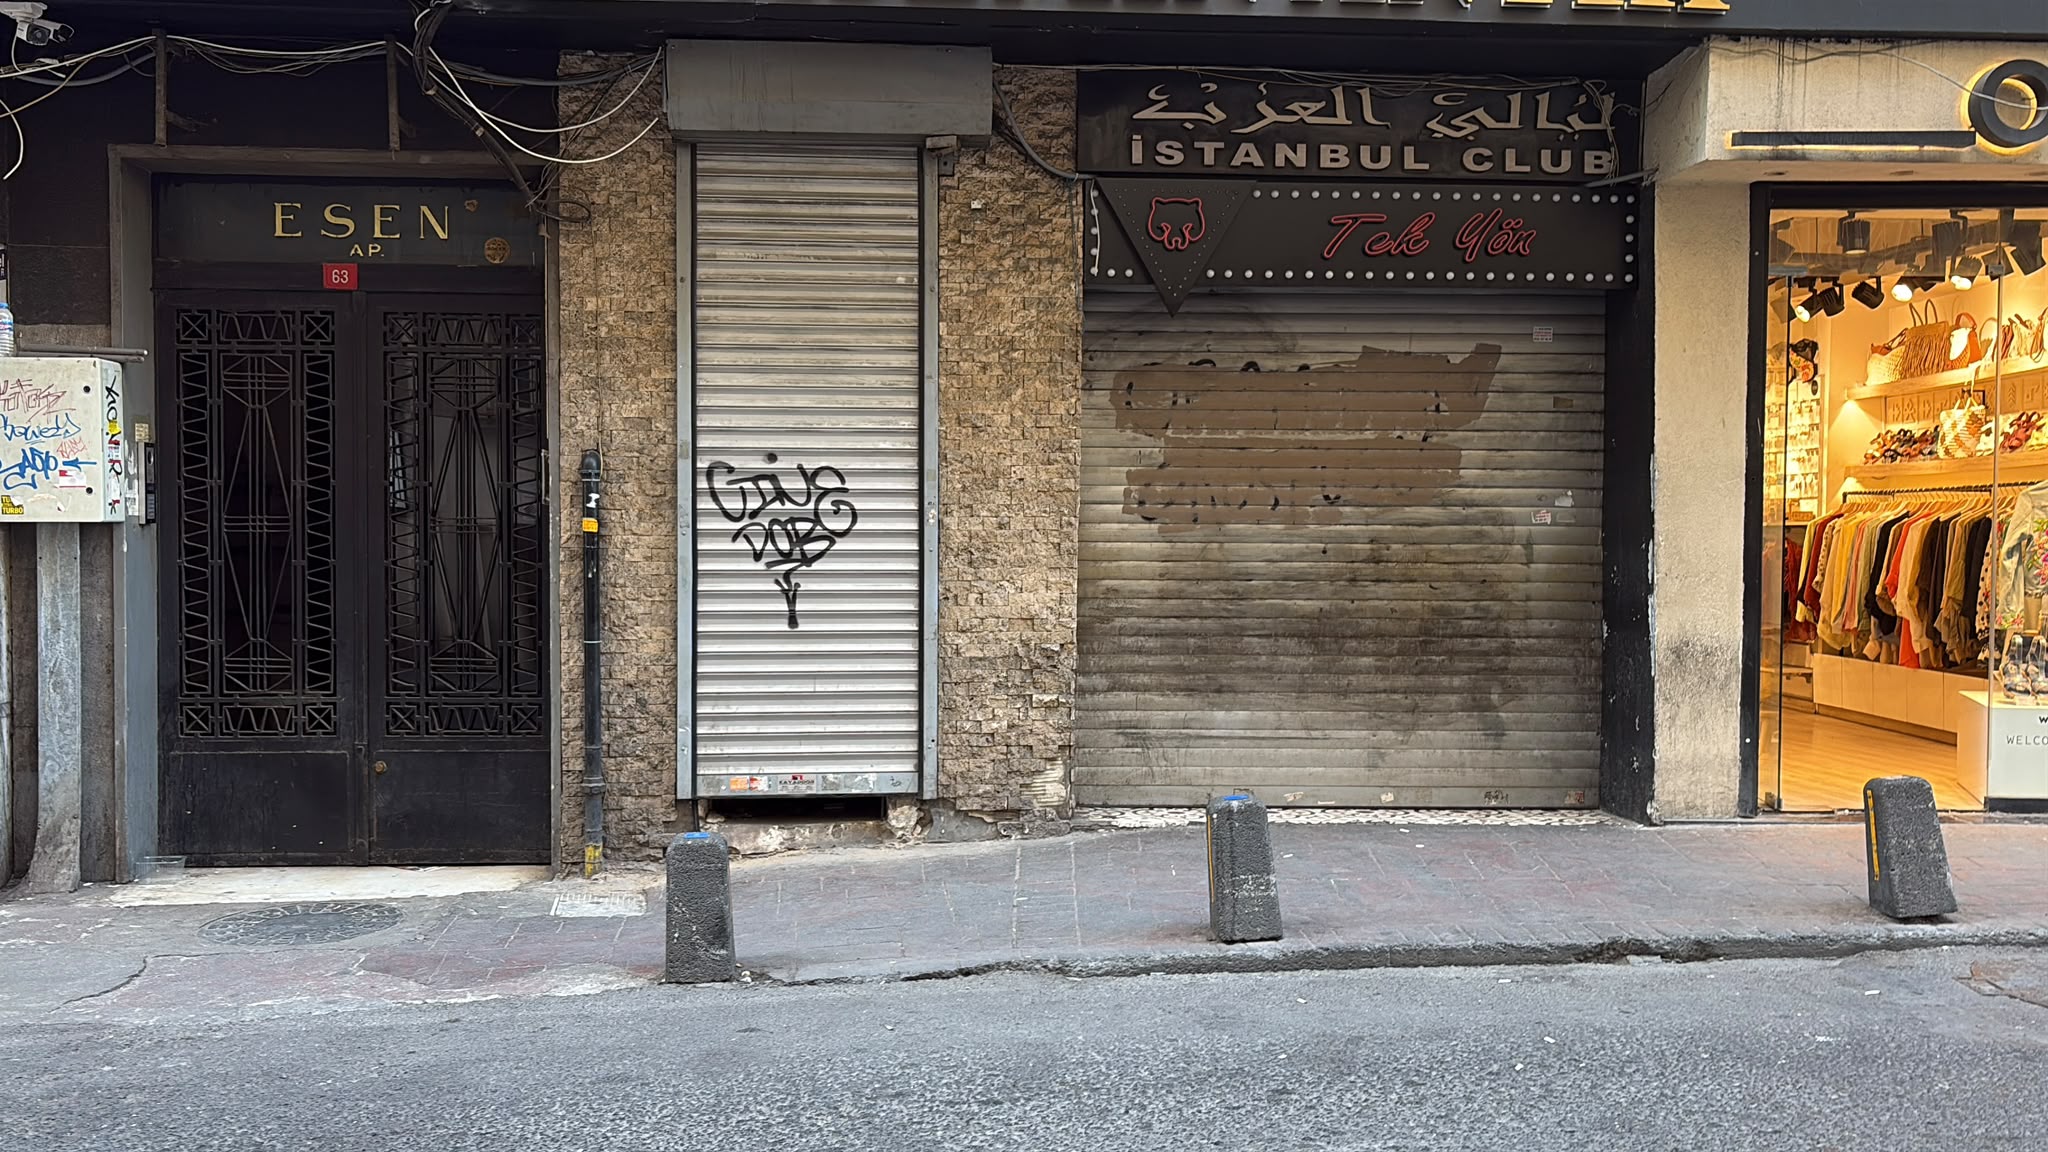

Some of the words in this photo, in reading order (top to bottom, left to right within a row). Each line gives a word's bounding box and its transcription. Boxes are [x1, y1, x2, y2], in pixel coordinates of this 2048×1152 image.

[1131, 134, 1430, 170] İSTANBUL
[1462, 147, 1612, 174] CLUB
[273, 202, 449, 240] ESEN
[1323, 211, 1436, 258] Tek
[1455, 207, 1537, 262] Yön
[349, 243, 385, 257] AP.
[331, 269, 349, 284] 63
